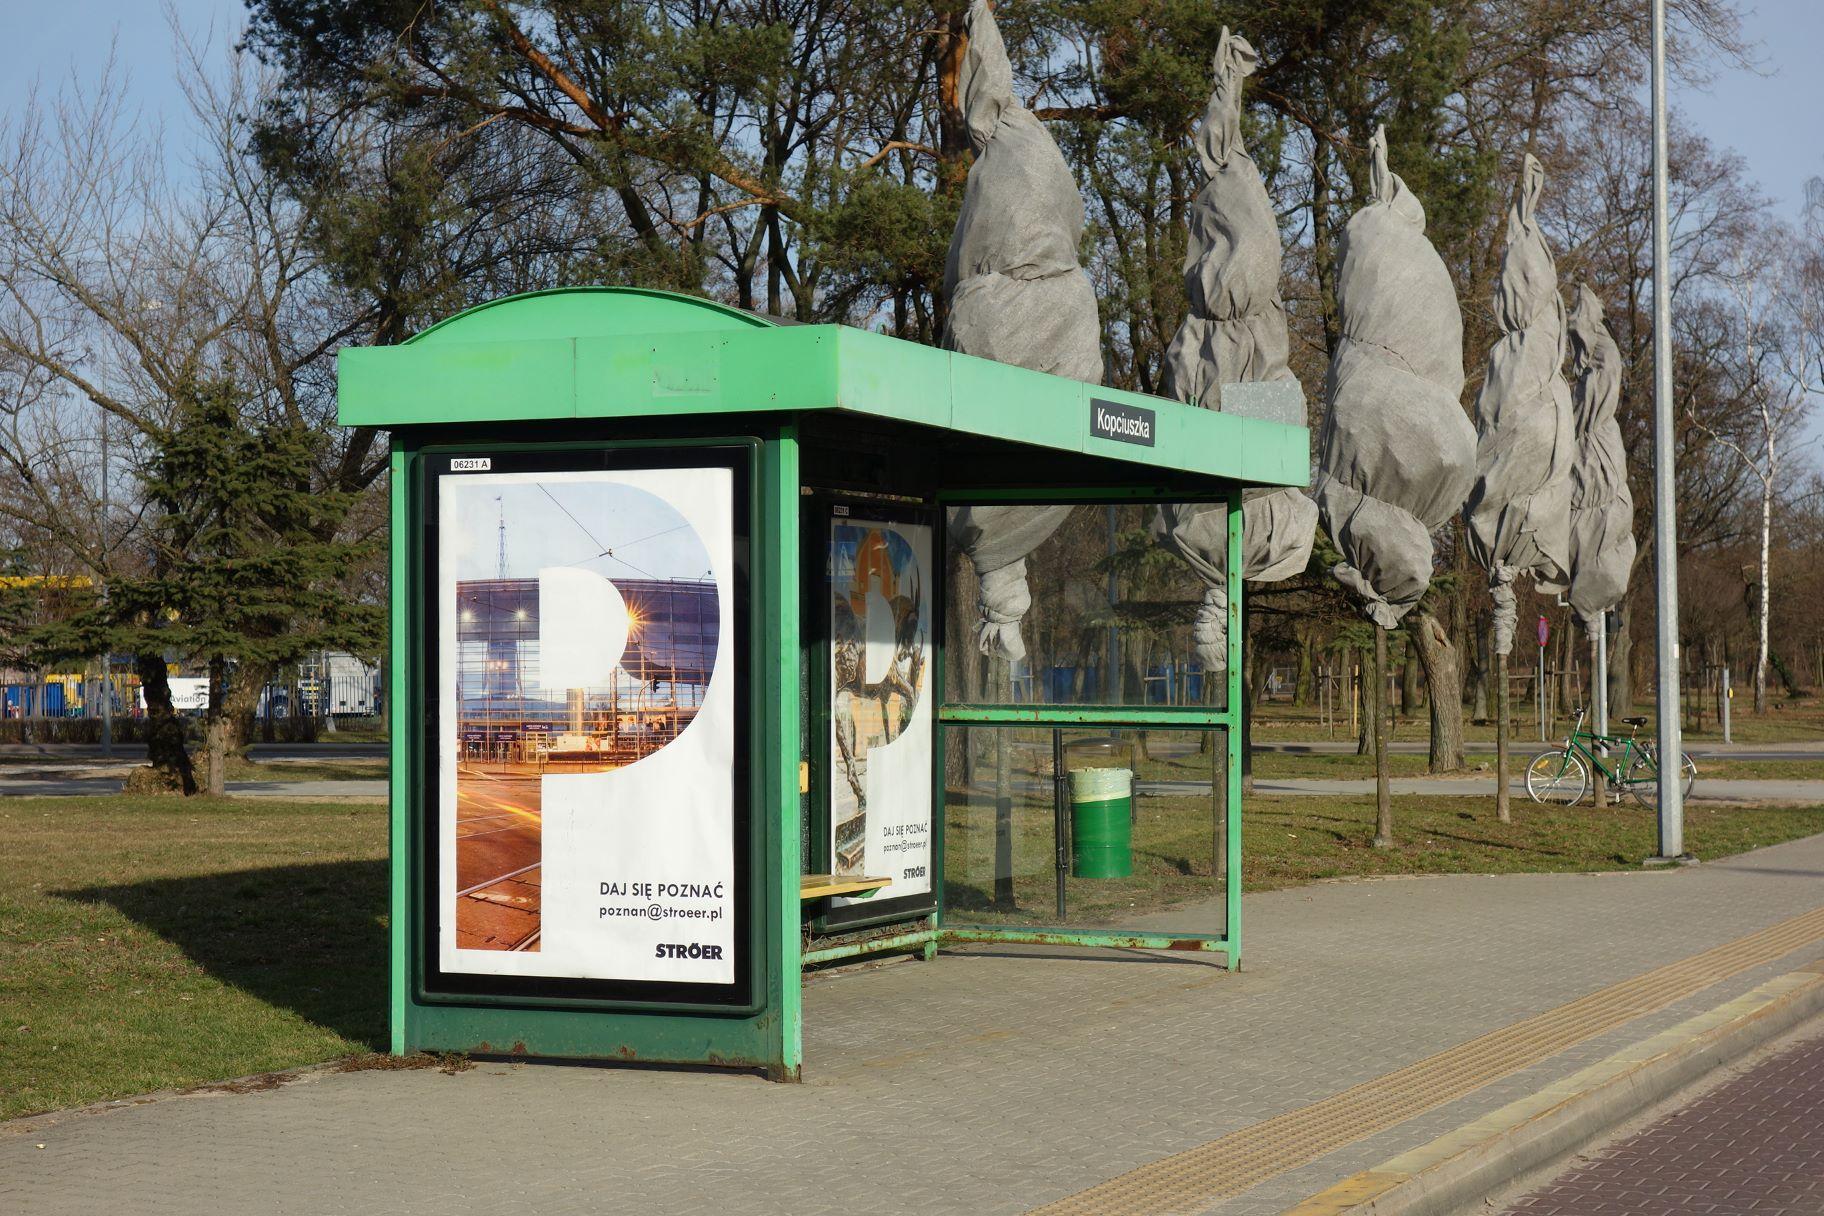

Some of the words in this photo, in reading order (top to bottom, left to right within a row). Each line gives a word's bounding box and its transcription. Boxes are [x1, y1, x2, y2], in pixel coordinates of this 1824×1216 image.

[1097, 407, 1150, 438] Kopciuszka
[454, 460, 479, 468] 06231
[481, 460, 488, 468] A
[170, 694, 206, 703] Aviation
[600, 882, 627, 896] DAJ
[632, 882, 652, 900] SIĘ
[658, 881, 723, 899] POZNAĆ
[600, 903, 722, 921] poznan@stroeer.pl
[655, 943, 722, 960] STRÖER
